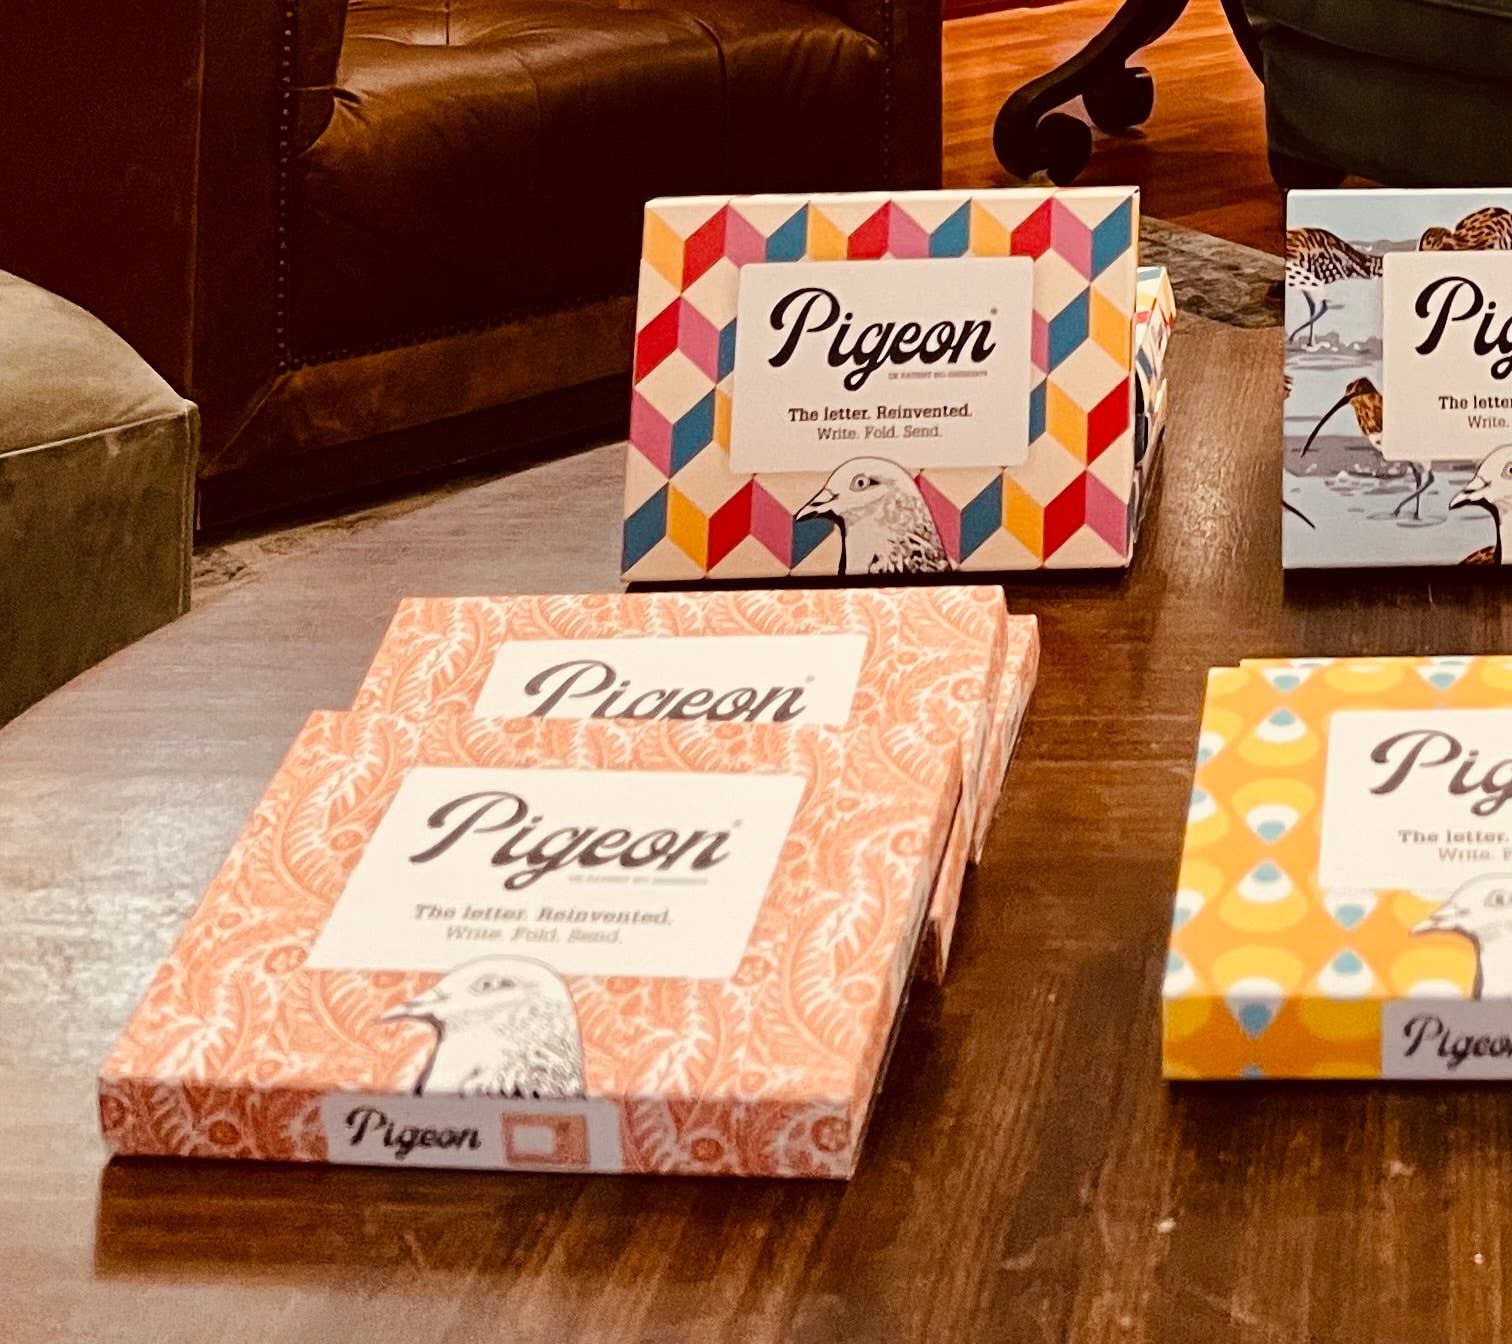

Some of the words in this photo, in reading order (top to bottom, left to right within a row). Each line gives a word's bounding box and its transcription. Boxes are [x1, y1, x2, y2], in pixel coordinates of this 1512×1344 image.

[768, 287, 997, 392] Pigeon
[1438, 396, 1468, 410] The
[788, 407, 819, 423] The
[824, 406, 871, 421] letter.
[877, 403, 973, 420] Reinvented.
[1467, 415, 1510, 429] Write.
[817, 426, 859, 441] Write.
[864, 425, 898, 440] Fold.
[902, 424, 943, 439] Send.
[524, 658, 808, 723] Pigeon
[409, 790, 732, 892] Pigeon
[1397, 829, 1439, 844] The
[414, 904, 457, 921] The
[341, 1106, 482, 1160] Pigeon
